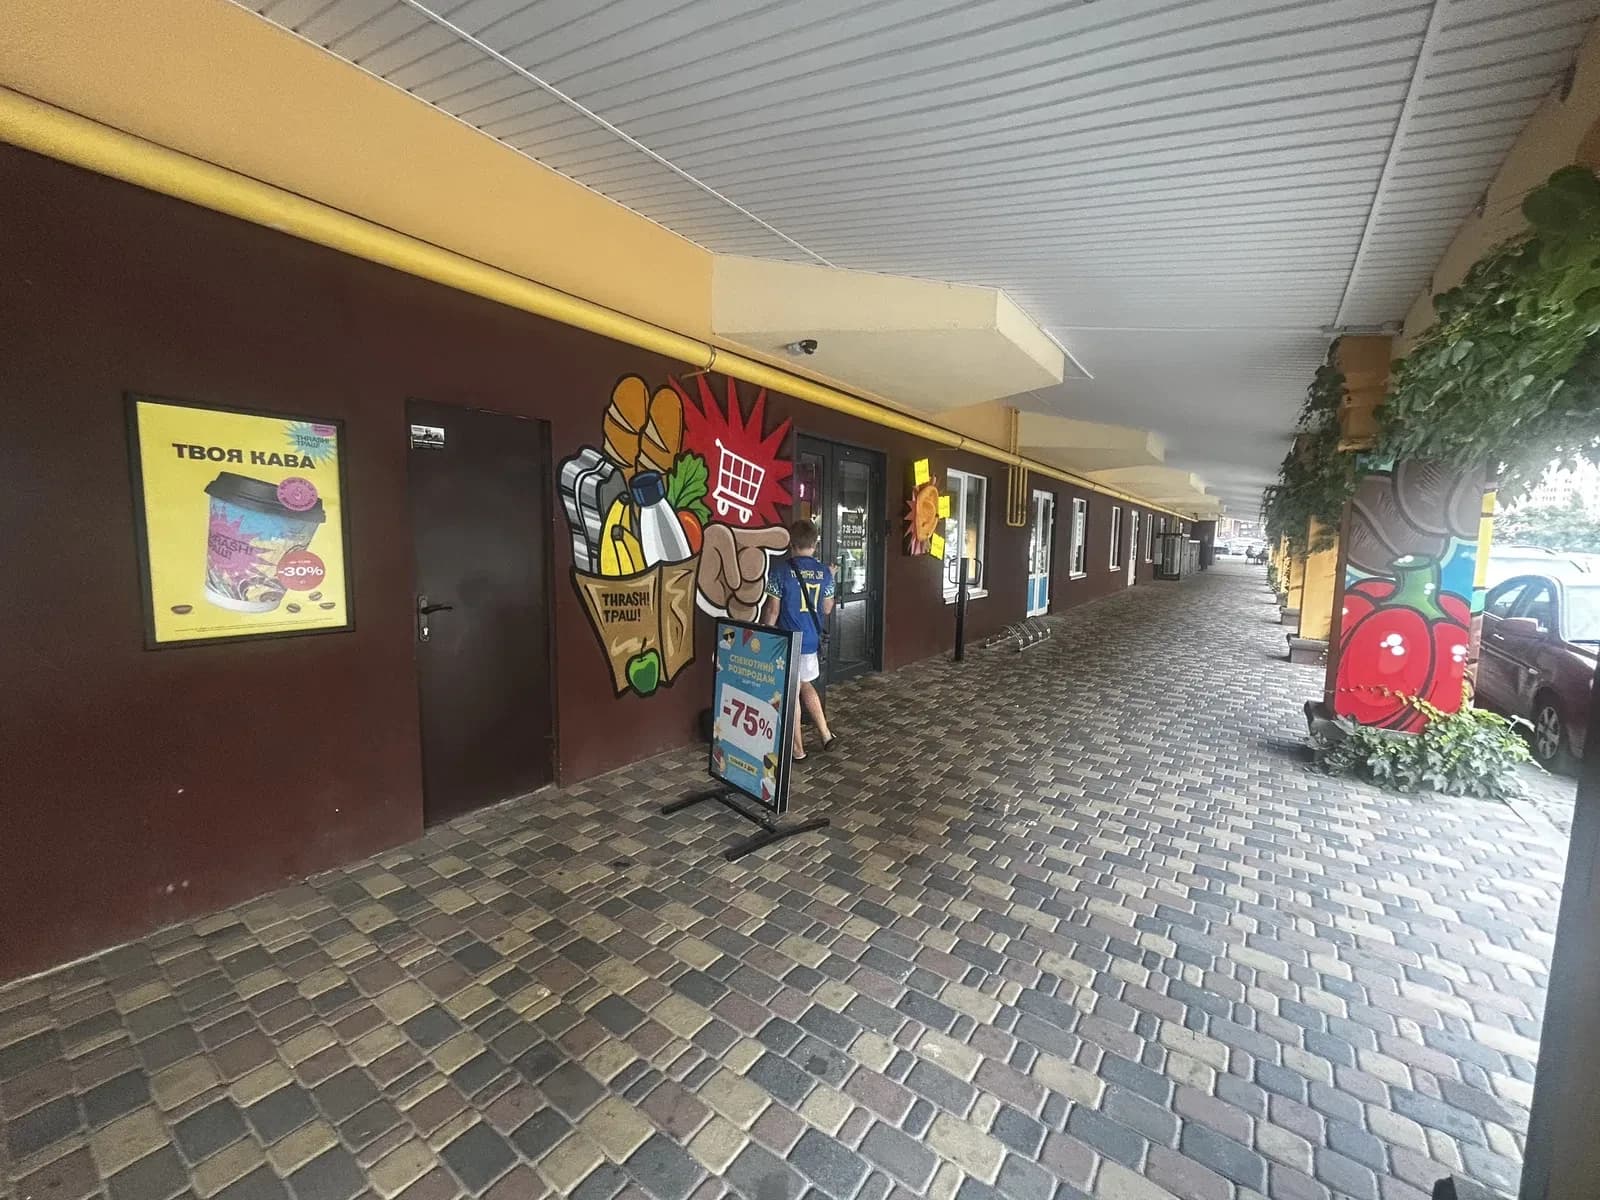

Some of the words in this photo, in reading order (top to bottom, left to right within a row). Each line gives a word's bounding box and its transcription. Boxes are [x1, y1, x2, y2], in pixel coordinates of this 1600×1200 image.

[172, 443, 243, 464] ТВОЯ
[251, 451, 316, 469] КАВА
[278, 566, 324, 577] -30%
[601, 591, 650, 607] THRASH!
[799, 581, 821, 613] 17
[603, 608, 641, 623] ТРАШ!
[723, 698, 773, 740] -75%
